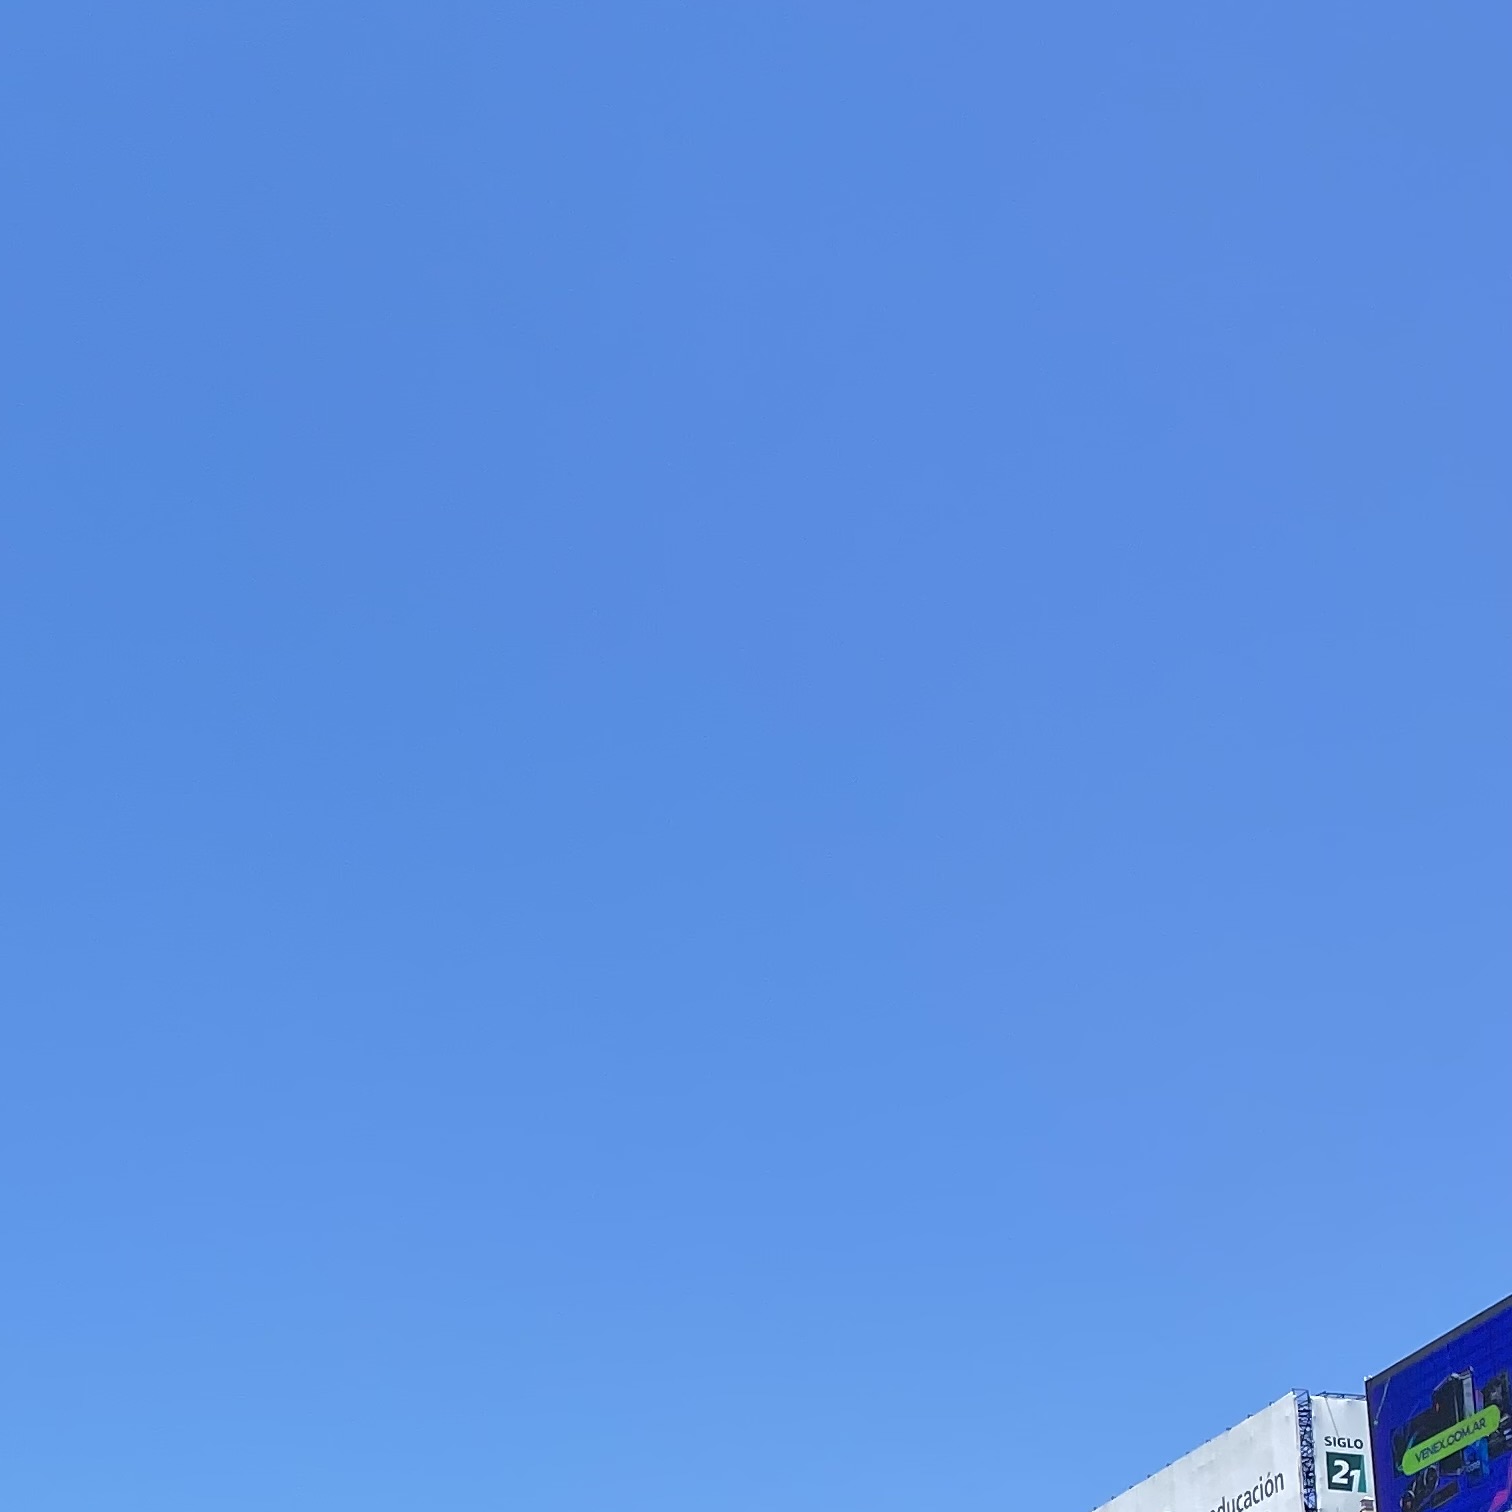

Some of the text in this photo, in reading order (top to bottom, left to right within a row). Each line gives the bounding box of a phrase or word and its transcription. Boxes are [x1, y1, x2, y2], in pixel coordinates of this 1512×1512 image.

[1324, 1436, 1364, 1449] SIGLO
[1415, 1417, 1486, 1463] VENEX.COM.AR
[1332, 1460, 1361, 1492] 21
